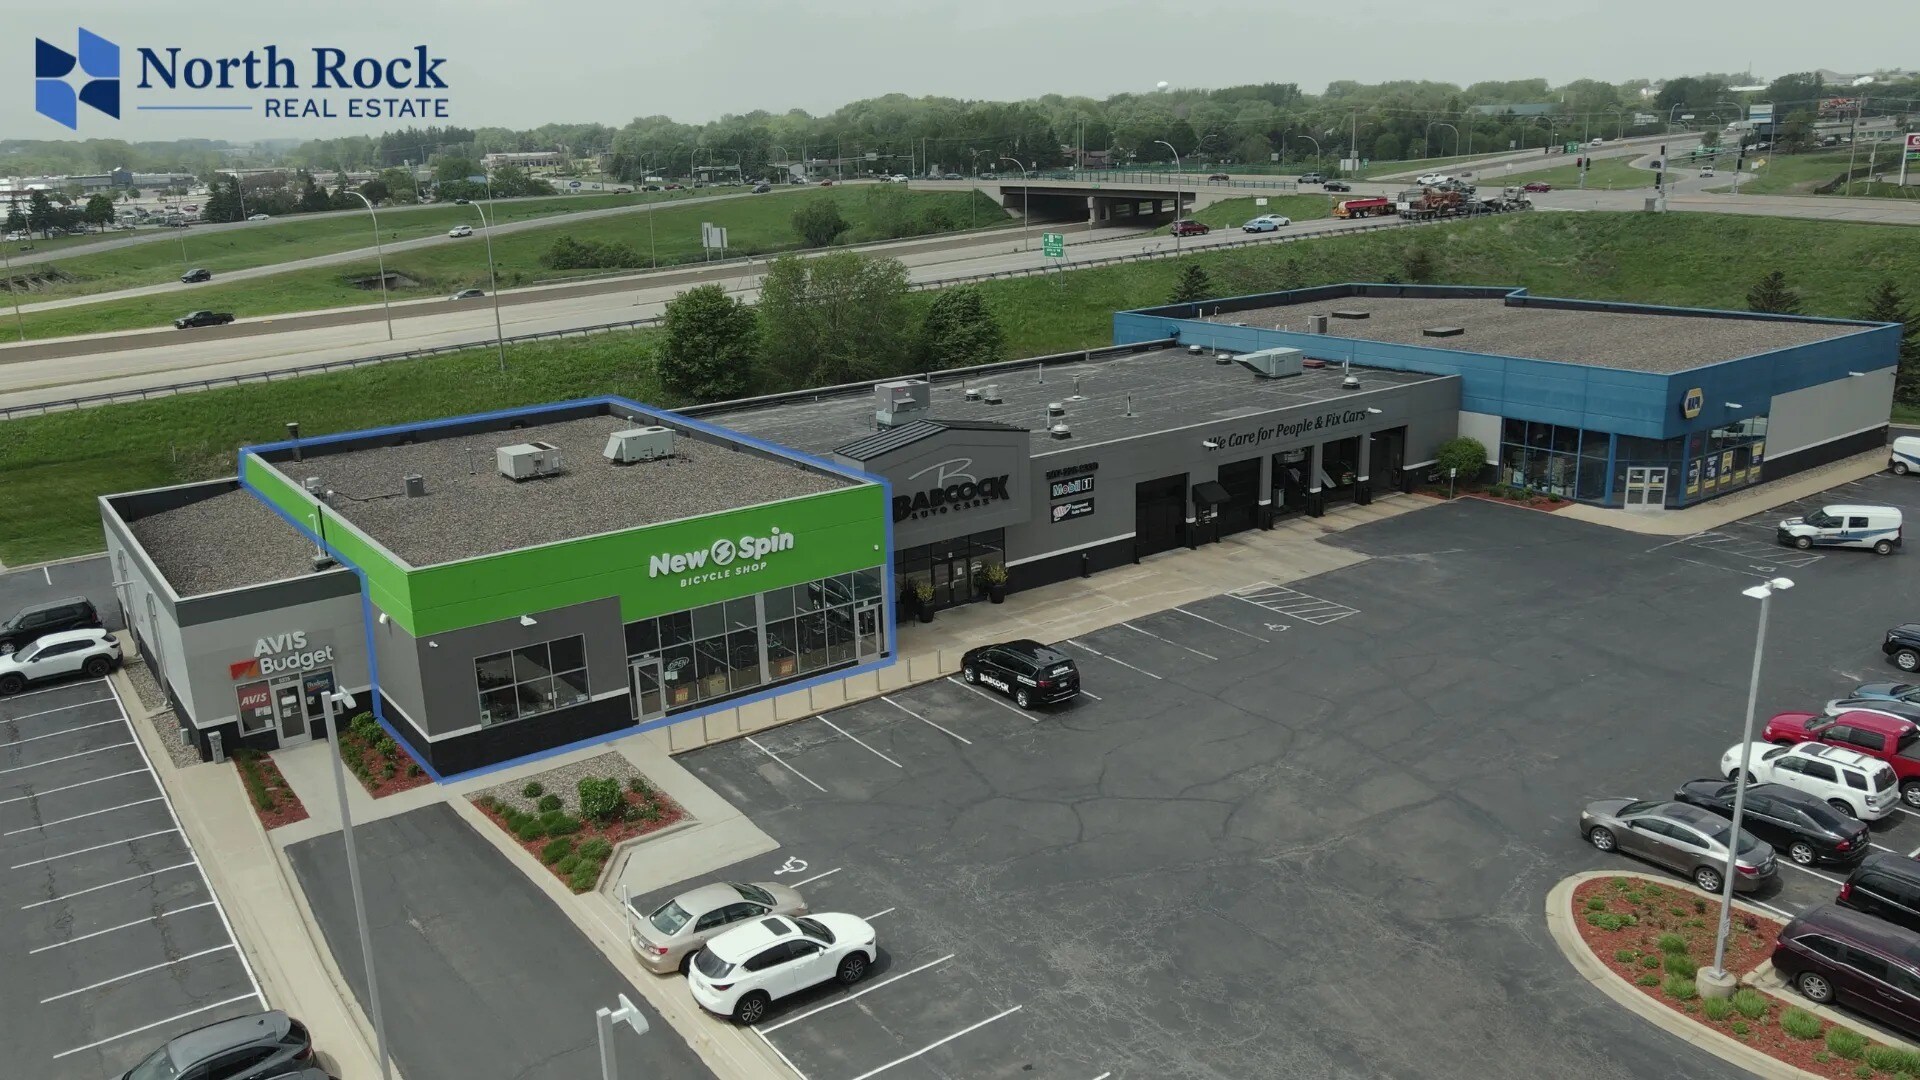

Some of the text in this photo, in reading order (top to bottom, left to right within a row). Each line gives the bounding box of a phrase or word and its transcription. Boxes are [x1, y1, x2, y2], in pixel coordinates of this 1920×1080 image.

[1207, 410, 1366, 451] We Care for People & Fix Cars
[892, 474, 1010, 523] BABCOCK
[1053, 480, 1081, 497] Mobil
[911, 506, 948, 520] AUTO
[649, 526, 794, 578] New Spin
[680, 561, 768, 587] BICYCLE SHOP
[253, 631, 308, 658] AVIS
[260, 645, 334, 675] Budget
[668, 659, 688, 671] OPEN
[980, 672, 1010, 693] BABCOCK
[241, 692, 267, 707] AVIS
